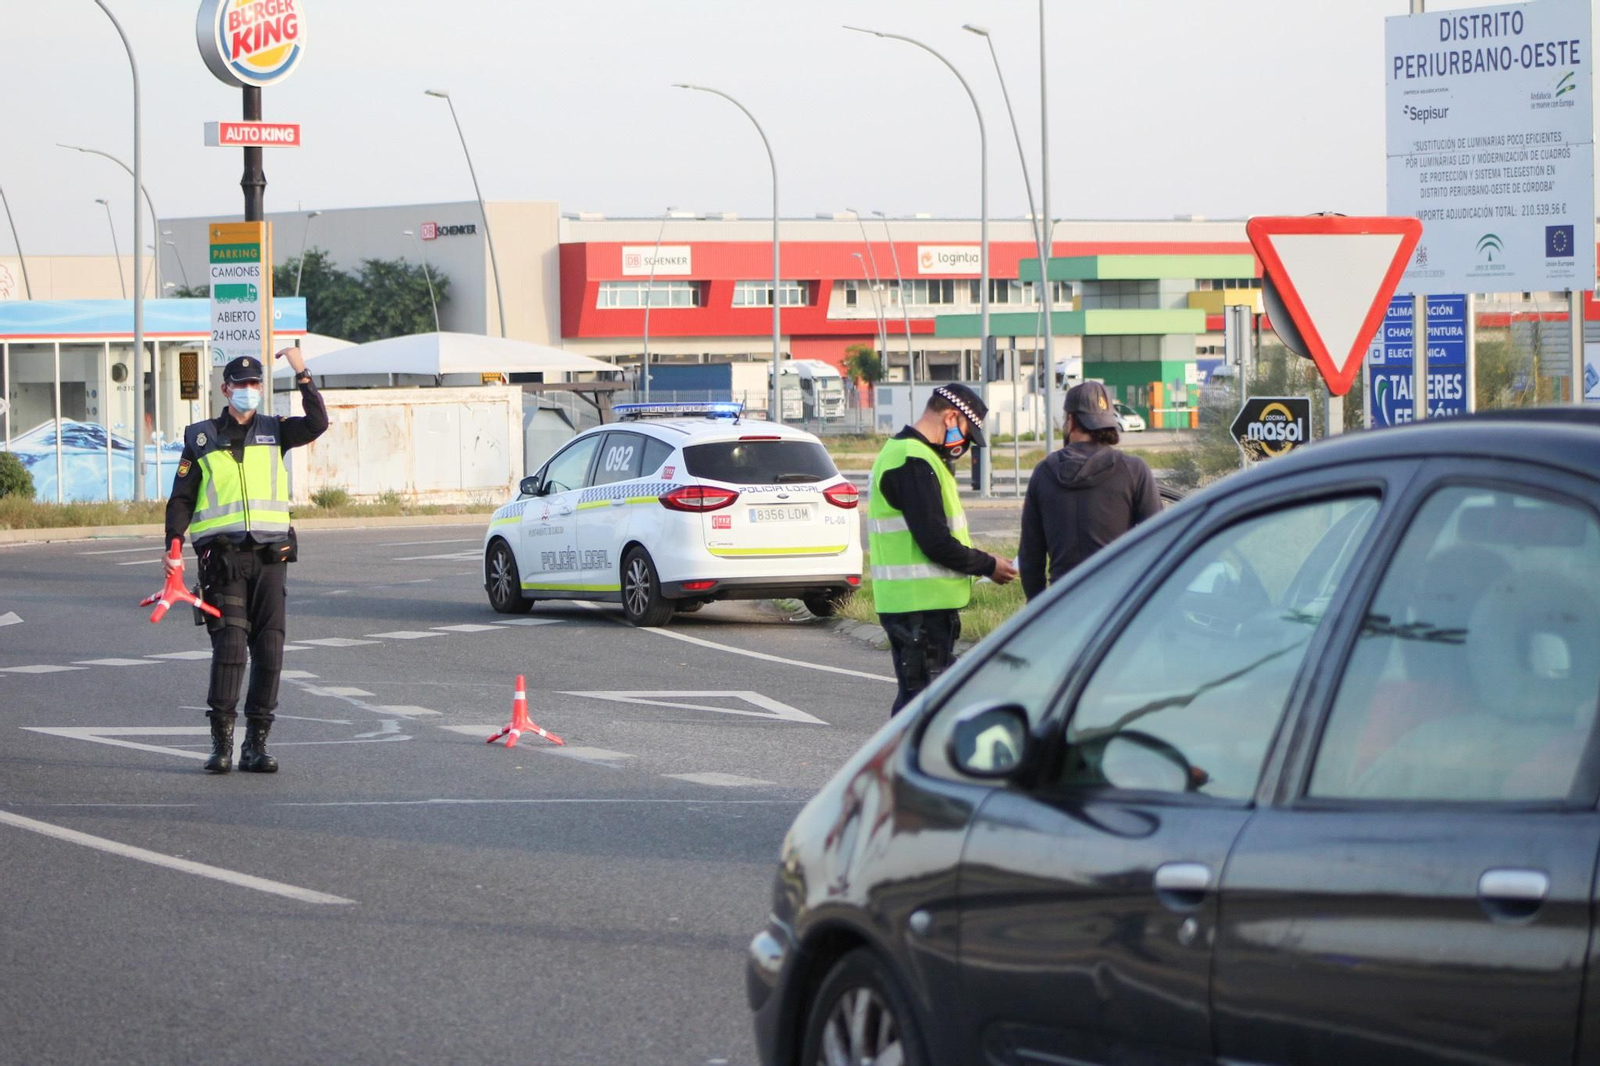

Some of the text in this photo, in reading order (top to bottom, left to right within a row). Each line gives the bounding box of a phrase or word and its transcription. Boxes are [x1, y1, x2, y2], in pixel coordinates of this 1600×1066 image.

[228, 0, 295, 32] BURGER
[1439, 10, 1524, 42] DISTRITO
[232, 13, 298, 60] KING
[1393, 39, 1581, 80] PERIURBANO-OESTE
[1409, 105, 1449, 125] Sepisur
[226, 126, 294, 142] AUTO KING
[1457, 138, 1466, 149] DE
[1467, 136, 1505, 148] LUMINARIAS
[1507, 134, 1524, 145] POCO
[1526, 131, 1562, 144] EFICIENTES
[1406, 158, 1418, 168] POR
[1420, 155, 1457, 168] LUMINARIAS
[1458, 154, 1470, 165] LED
[1472, 154, 1476, 164] Y
[1530, 150, 1539, 160] DE
[1541, 148, 1571, 160] CUADROS
[1420, 173, 1428, 183] DE
[1470, 169, 1474, 179] Y
[1475, 168, 1501, 180] SISTEMA
[1547, 165, 1555, 176] EN
[1420, 187, 1448, 199] DISTRITO
[1450, 183, 1511, 197] PERIURBANO-OESTE
[1512, 182, 1521, 193] DE
[1415, 208, 1444, 221] IMPORTE
[1495, 205, 1518, 217] TOTAL:
[1562, 202, 1567, 214] €
[423, 224, 476, 237] DB SCHENKER
[213, 249, 258, 259] PARKING
[627, 255, 688, 267] DB SCHENKER
[211, 266, 260, 278] CAMIONES
[217, 311, 256, 323] ABIERTO
[213, 329, 261, 341] 24 HORAS
[1247, 417, 1303, 441] masol
[605, 445, 635, 472] 092
[786, 485, 822, 494] LOCAL
[757, 508, 809, 521] 8356 LDM
[579, 549, 613, 571] LOCAL
